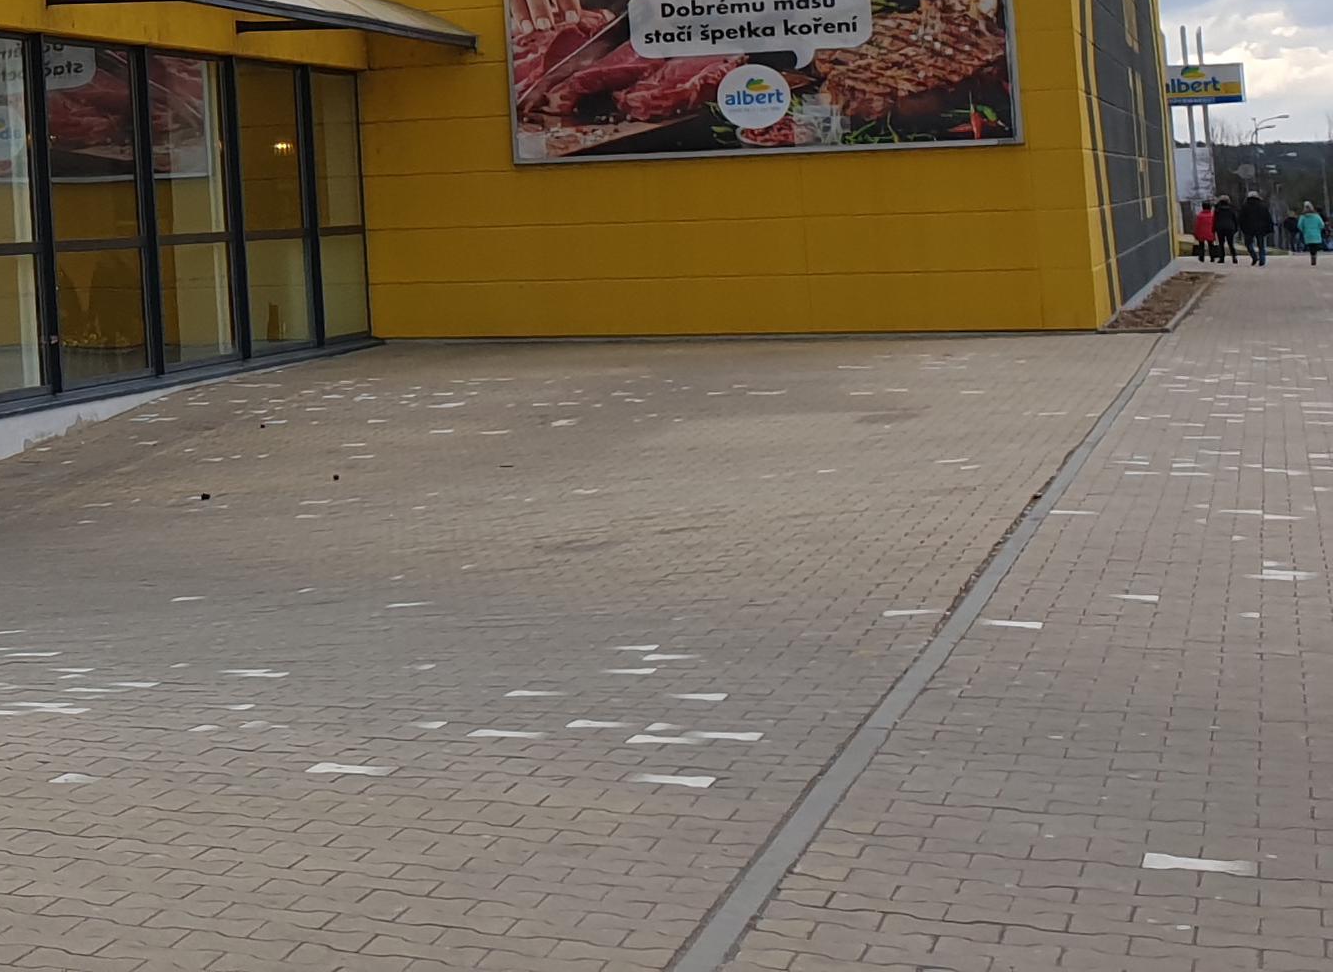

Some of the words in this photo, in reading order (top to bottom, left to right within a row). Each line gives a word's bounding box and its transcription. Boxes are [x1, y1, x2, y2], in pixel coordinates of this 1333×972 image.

[644, 25, 692, 45] stačí
[700, 21, 776, 45] špetka
[783, 15, 859, 36] koření
[725, 89, 784, 105] albert
